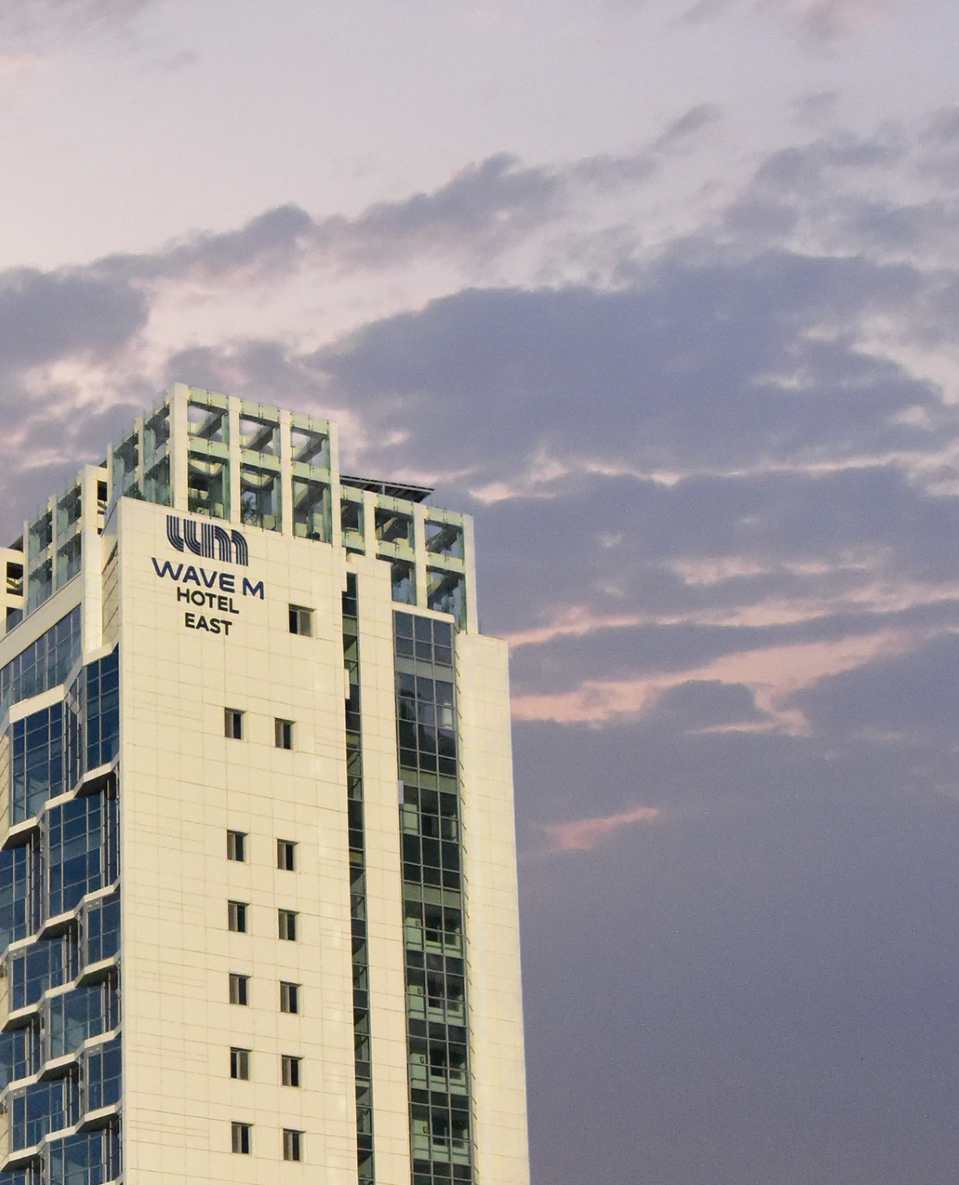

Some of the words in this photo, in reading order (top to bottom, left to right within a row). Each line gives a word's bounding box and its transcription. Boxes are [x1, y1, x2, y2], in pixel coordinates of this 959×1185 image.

[151, 556, 235, 593] WAVE
[242, 577, 265, 600] M
[177, 586, 240, 614] HOTEL
[185, 612, 233, 636] EAST
